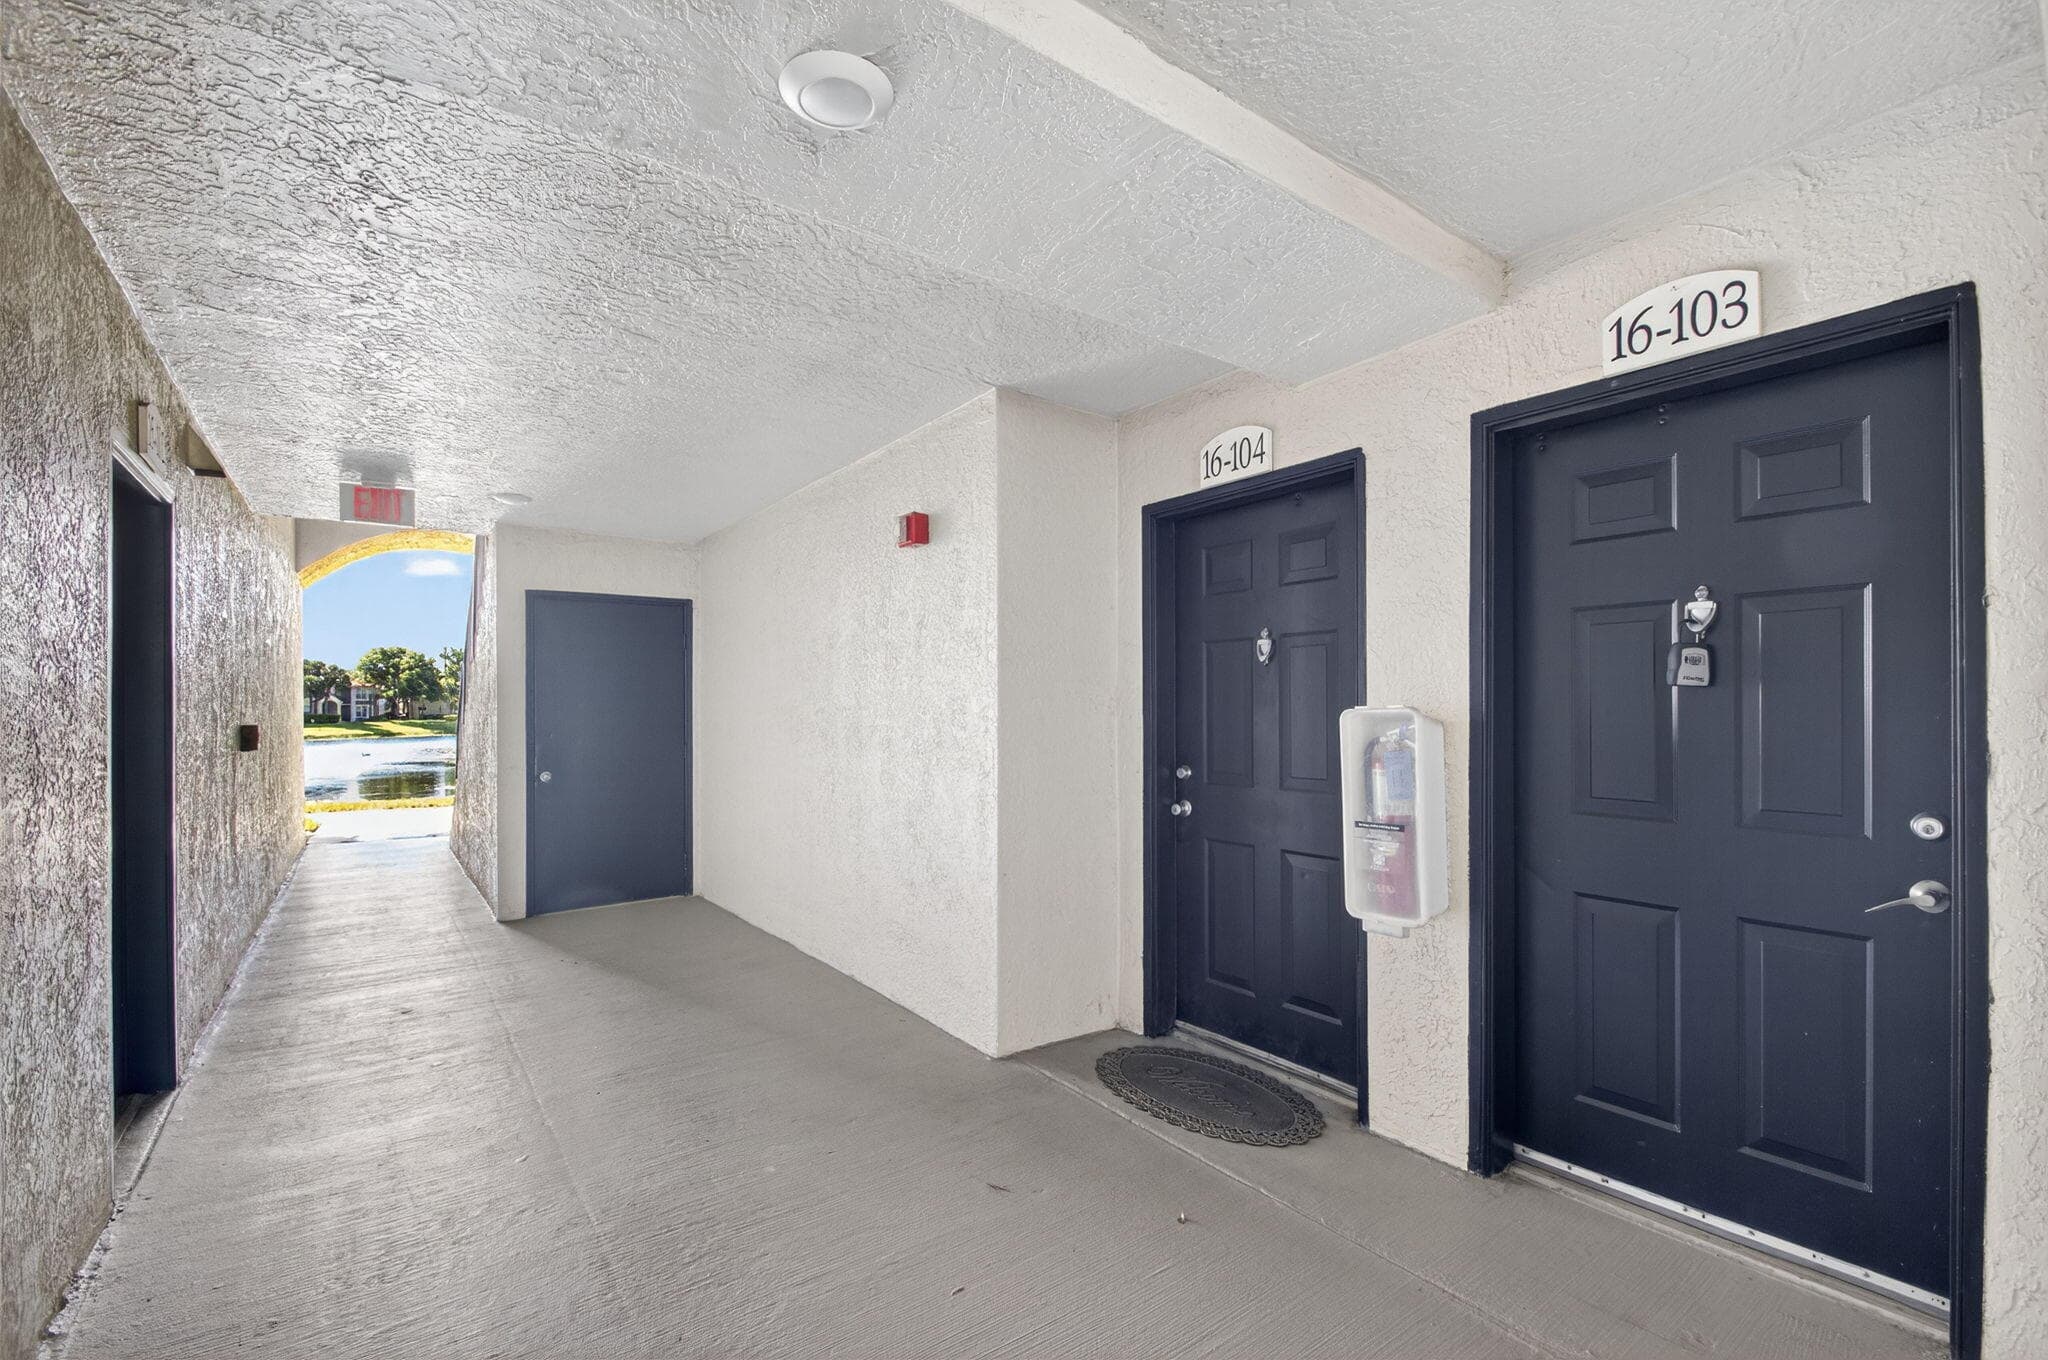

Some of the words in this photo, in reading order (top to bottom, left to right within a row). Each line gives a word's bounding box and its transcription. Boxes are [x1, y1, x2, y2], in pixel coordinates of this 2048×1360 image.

[1609, 280, 1749, 363] 16-103
[1202, 432, 1266, 481] 16-104
[353, 485, 403, 523] EXIT
